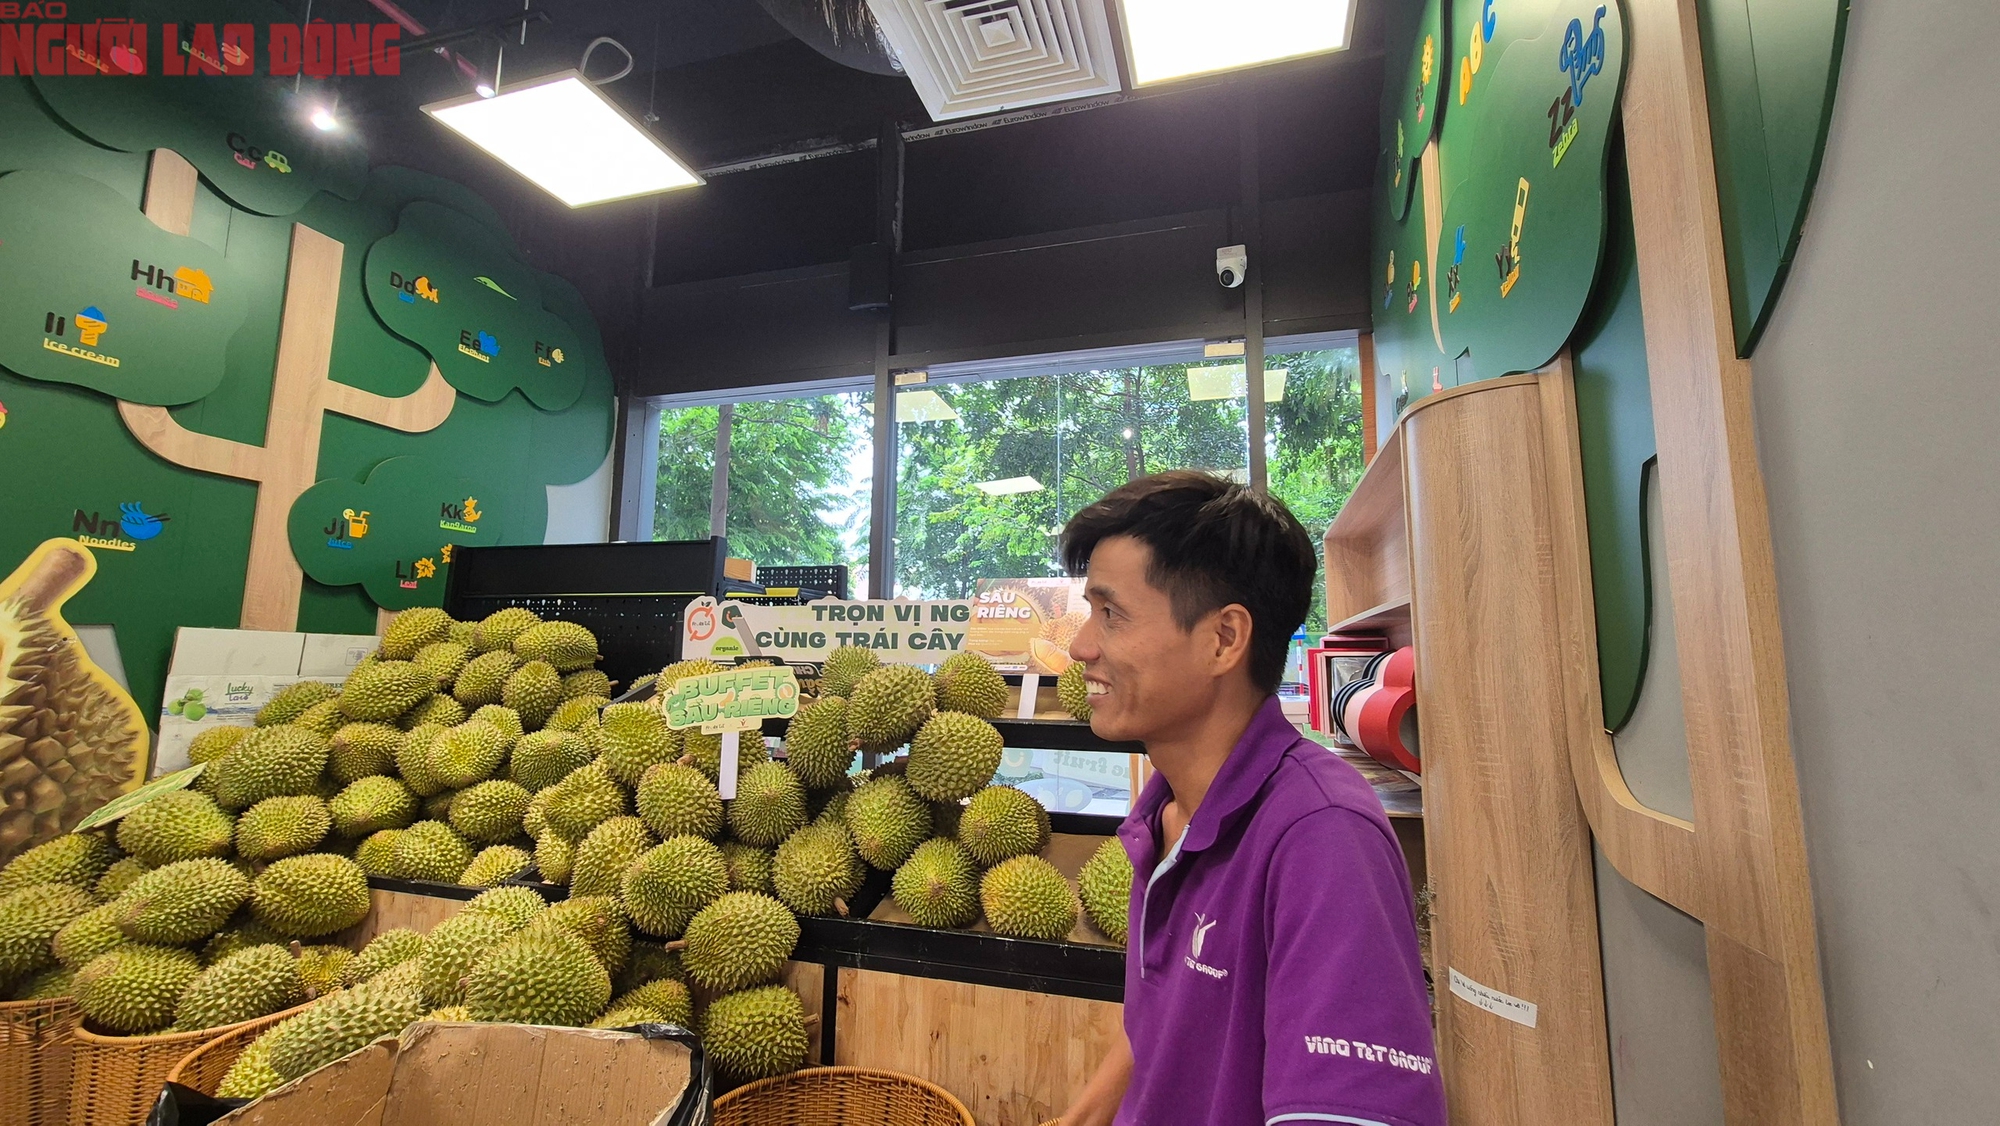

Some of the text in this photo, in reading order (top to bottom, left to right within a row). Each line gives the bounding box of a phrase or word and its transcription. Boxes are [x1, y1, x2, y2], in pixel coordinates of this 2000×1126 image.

[131, 259, 175, 293] Hh
[70, 346, 120, 368] cream
[73, 509, 120, 538] Nn
[79, 534, 136, 552] Noodles
[979, 587, 1016, 604] SẦU
[811, 604, 885, 626] TRỌN
[894, 604, 921, 626] VỊ
[976, 604, 1031, 619] RIÊNG
[755, 626, 827, 649] CÙNG
[836, 627, 899, 650] TRÁI
[907, 627, 965, 651] CÂY
[679, 669, 791, 700] BUFFET
[670, 696, 796, 727] SẦU RIÊNG
[1352, 1041, 1388, 1062] T&T
